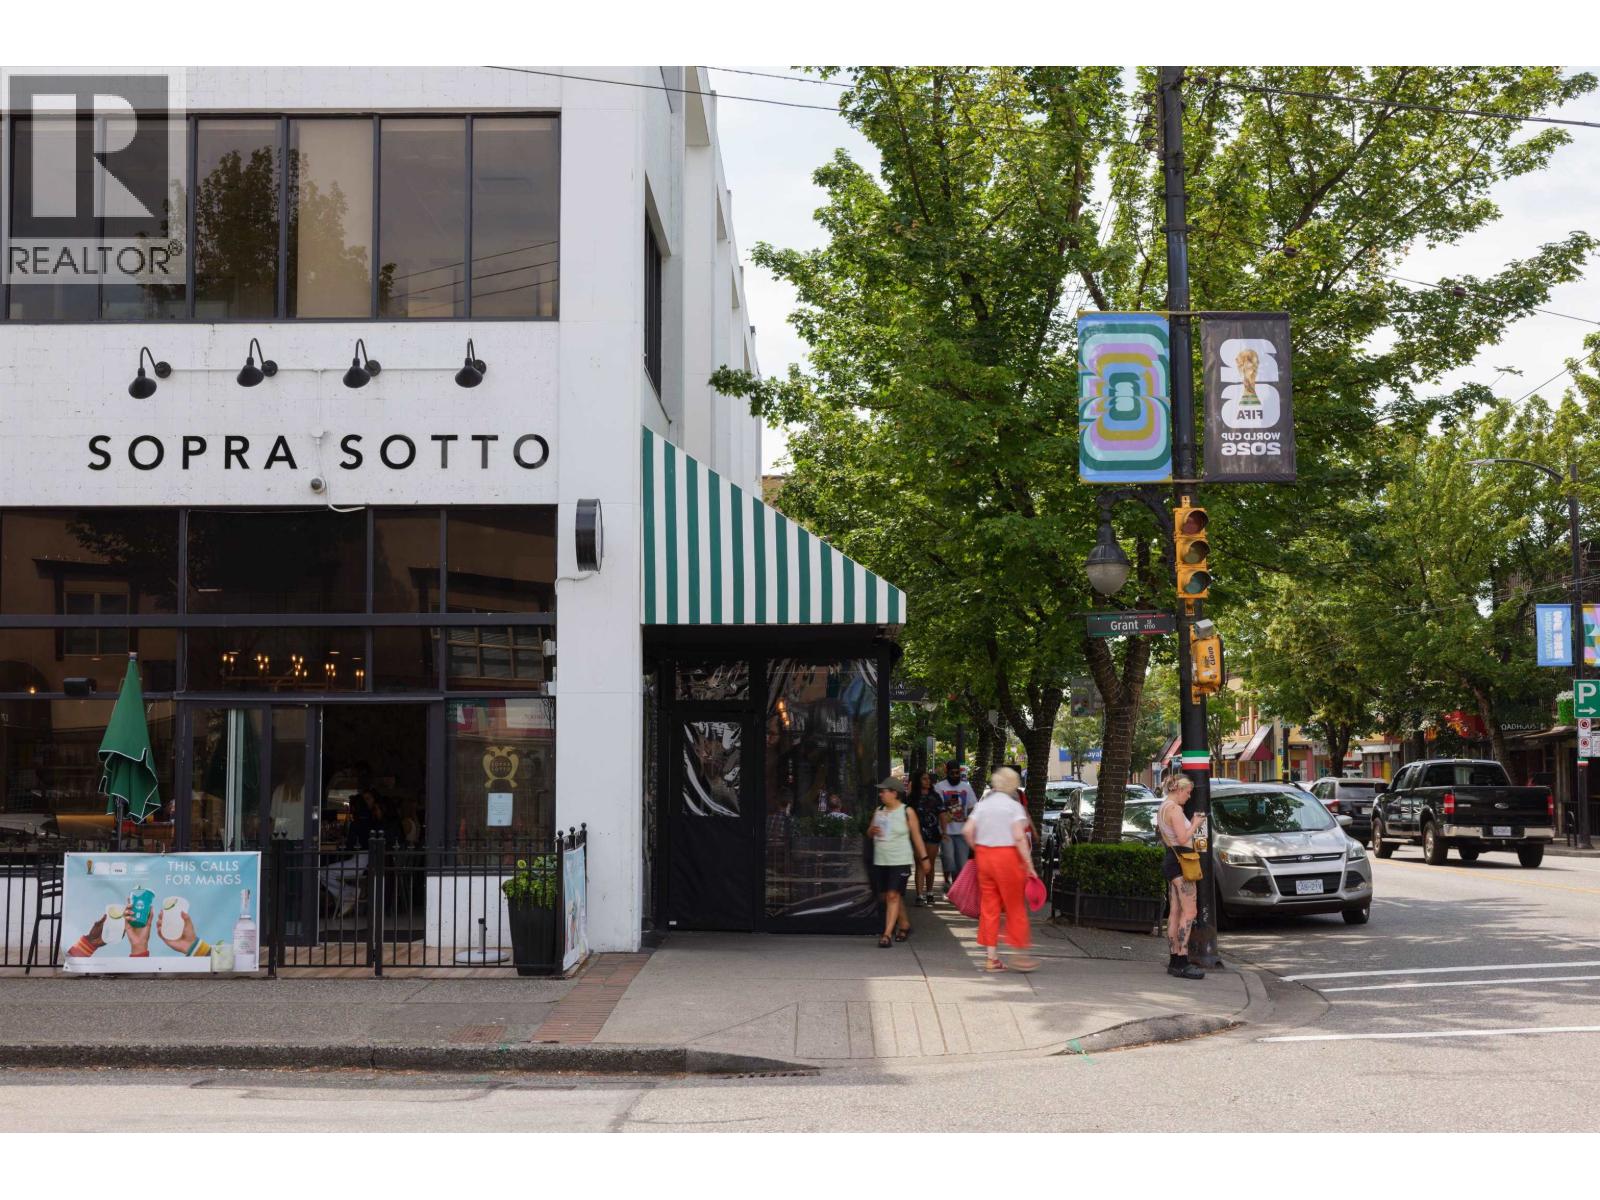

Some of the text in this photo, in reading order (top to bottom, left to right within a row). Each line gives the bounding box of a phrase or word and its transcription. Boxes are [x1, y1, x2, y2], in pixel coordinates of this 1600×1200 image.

[88, 433, 550, 471] SOPRA SOTTO
[1110, 619, 1139, 631] Grant
[1207, 646, 1216, 666] CLOUD
[1578, 682, 1597, 704] P
[167, 860, 240, 872] THIS CALLS
[165, 873, 242, 885] FOR MARGS
